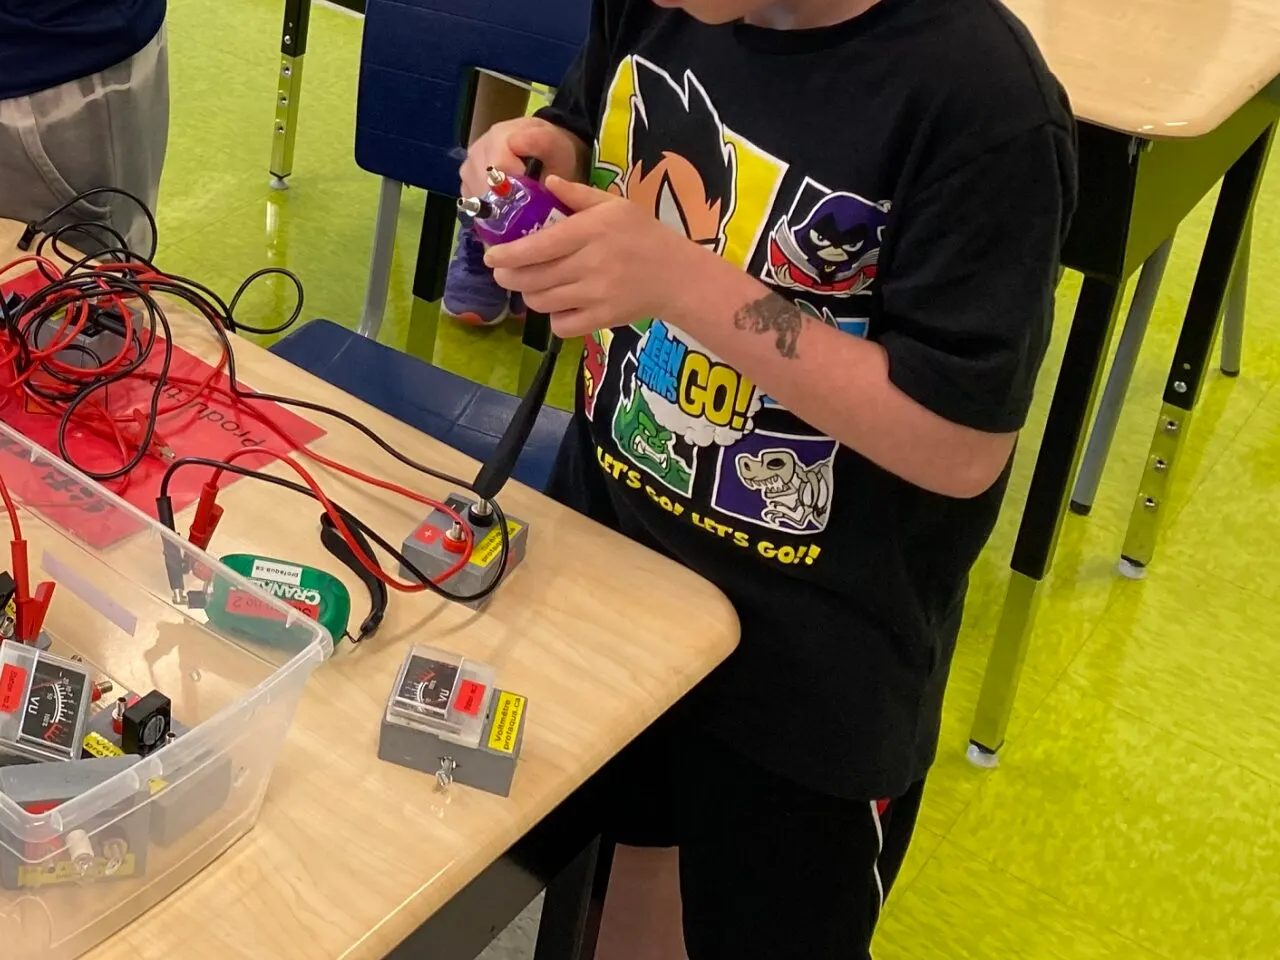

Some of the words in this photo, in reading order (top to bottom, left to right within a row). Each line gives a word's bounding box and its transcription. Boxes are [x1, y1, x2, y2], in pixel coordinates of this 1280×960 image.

[642, 320, 687, 374] TEEN
[679, 351, 753, 430] GO!
[597, 445, 641, 489] LET'S
[692, 512, 749, 547] LET'S
[757, 541, 821, 565] GO!!
[28, 696, 41, 715] VU
[438, 688, 450, 702] VU
[494, 699, 511, 742] Voltmètre
[503, 697, 521, 751] profaqua.ca
